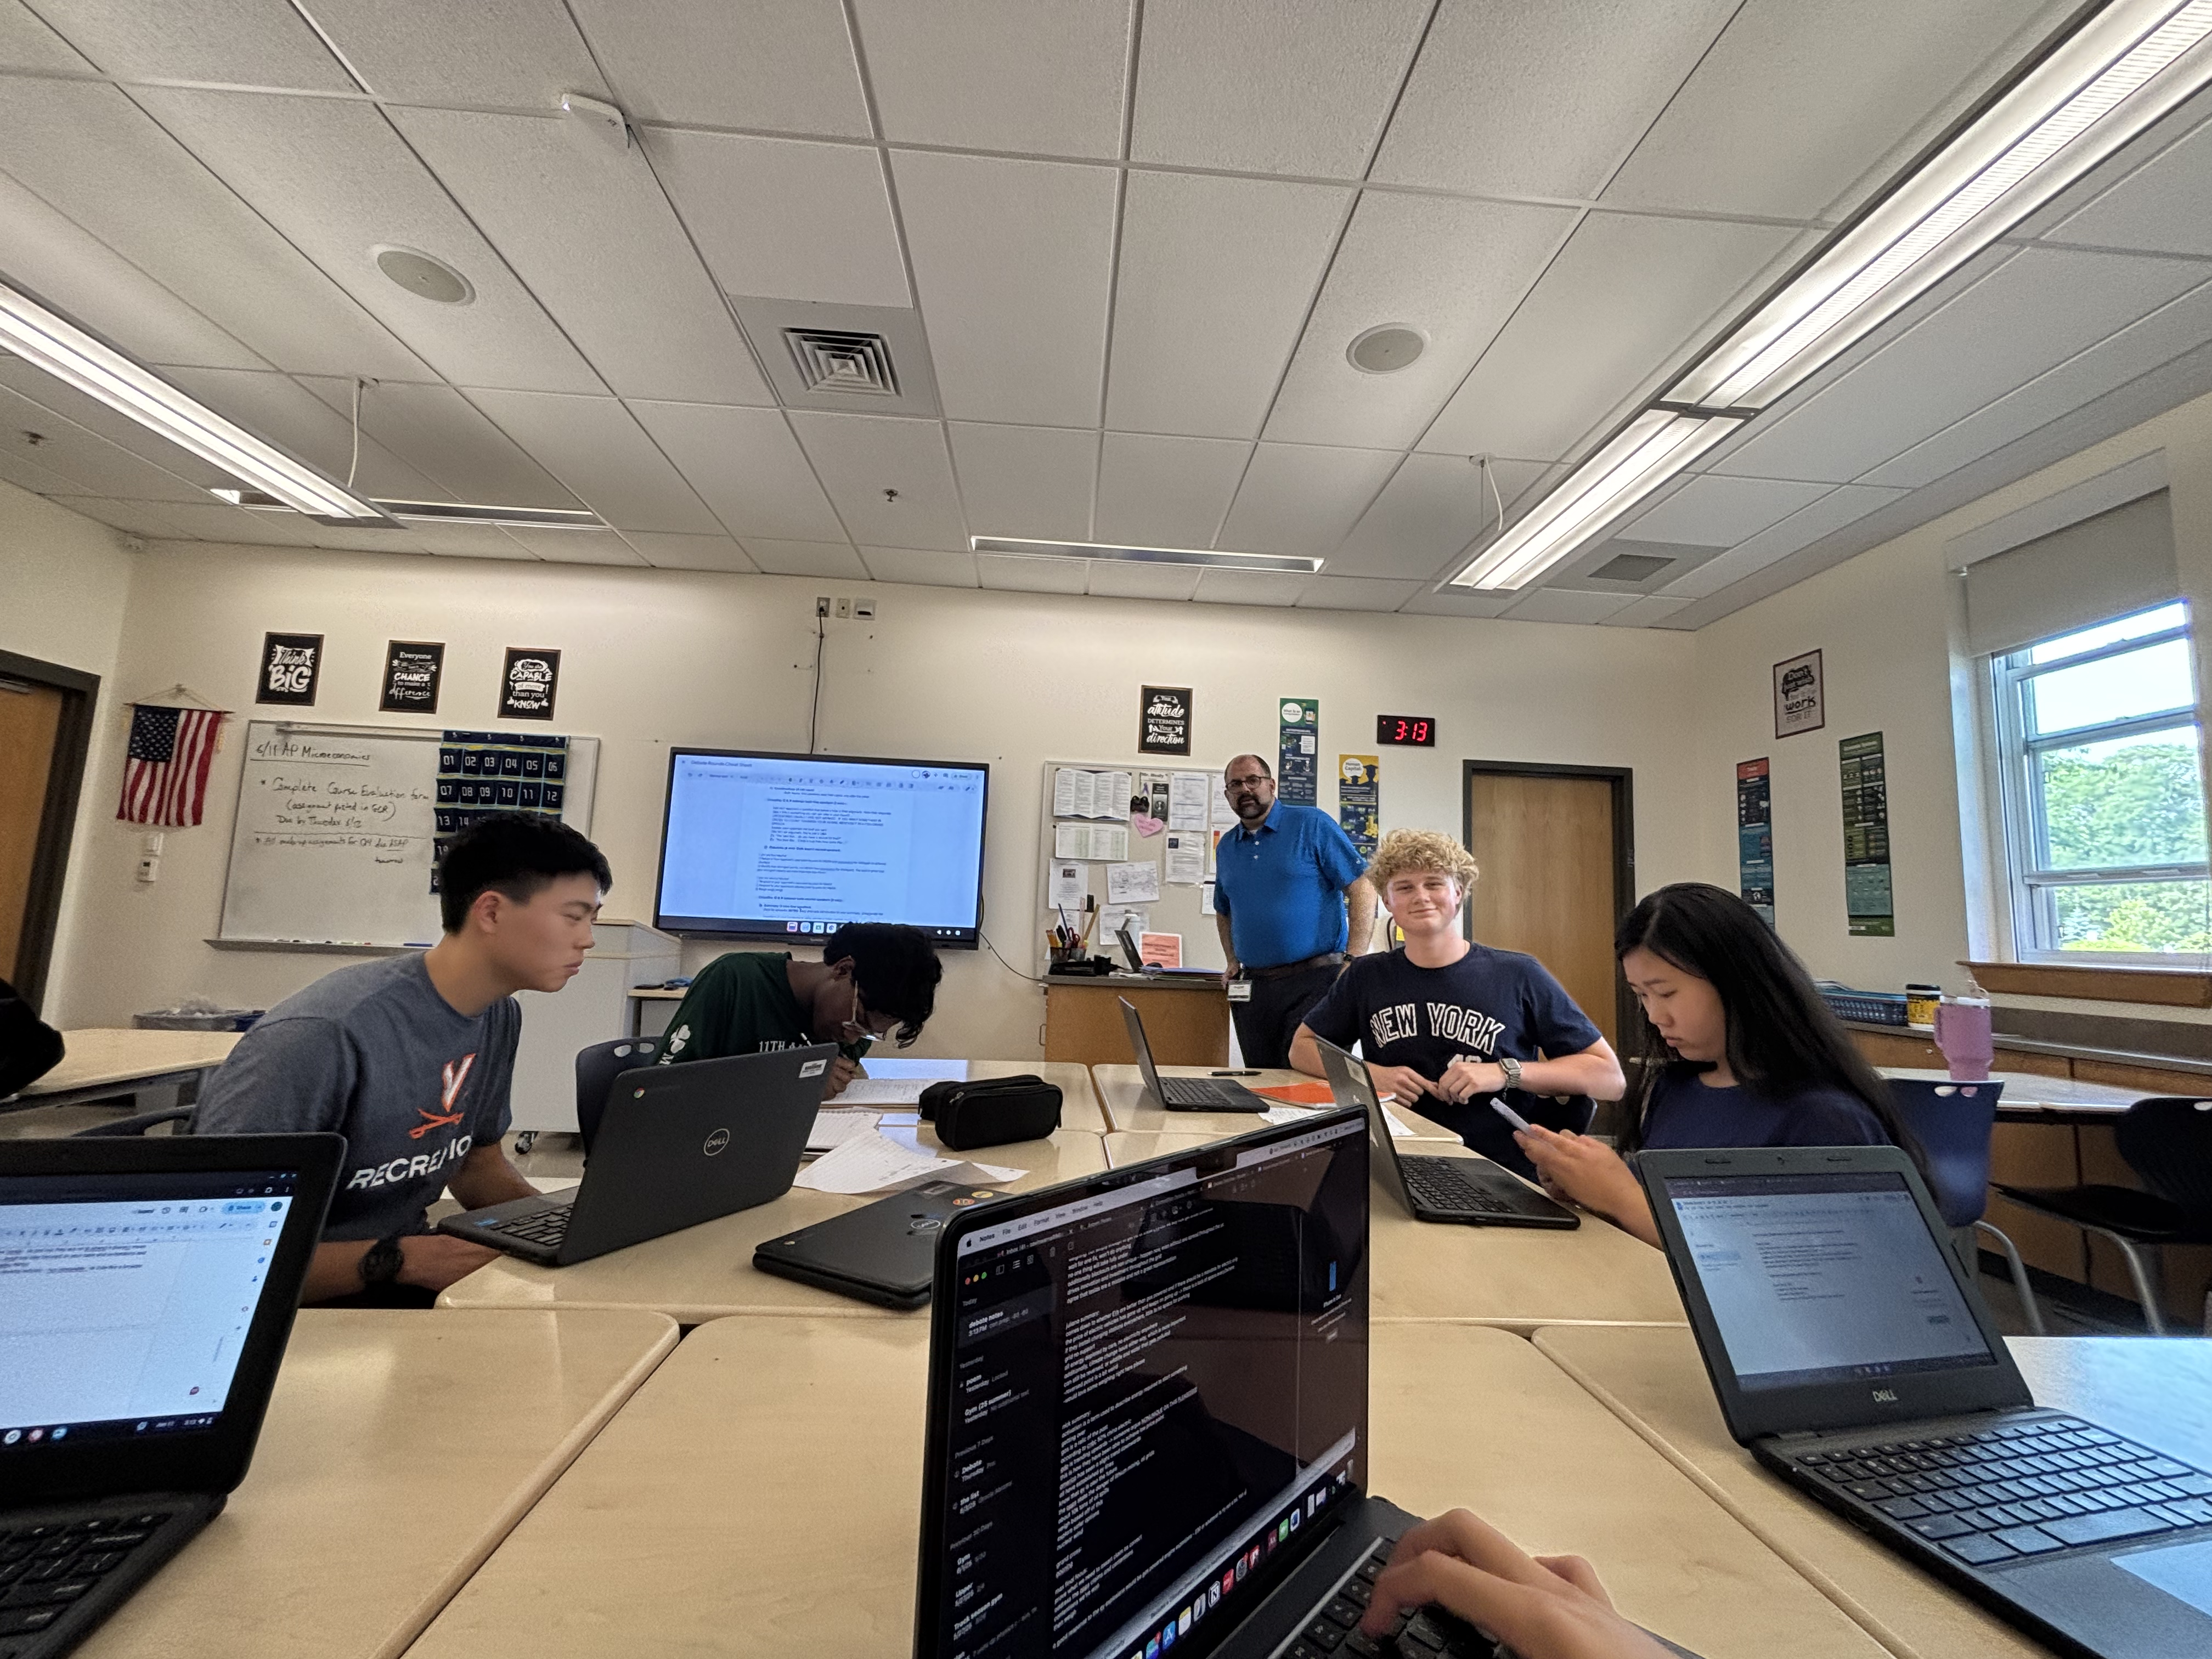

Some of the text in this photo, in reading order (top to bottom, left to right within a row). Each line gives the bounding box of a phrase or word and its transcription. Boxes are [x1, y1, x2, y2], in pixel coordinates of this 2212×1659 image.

[278, 648, 307, 664] Think
[399, 652, 432, 660] Everyone
[394, 672, 430, 681] CHANCE
[510, 670, 552, 682] CAPABLE
[389, 686, 430, 699] difference
[513, 699, 541, 709] KNOW
[1147, 703, 1184, 716] attitude
[1785, 695, 1816, 711] work
[1395, 720, 1427, 741] 3:13
[1146, 732, 1184, 744] direction
[283, 743, 298, 755] AP
[302, 747, 369, 761] Microeconomics
[443, 755, 557, 772] 01 02 03 04 05 06
[273, 777, 317, 793] Complete
[328, 782, 358, 795] Course
[440, 785, 557, 802] 07 08 09 10 11 12
[438, 815, 450, 826] 13
[459, 816, 469, 826] 14
[1370, 1002, 1506, 1056] NEW YORK
[759, 1041, 784, 1053] 11TH
[707, 1137, 727, 1148] DELL
[980, 1234, 995, 1242] Notes
[1034, 1217, 1049, 1226] Format
[969, 1311, 1003, 1328] debate notes
[967, 1375, 981, 1386] poem
[964, 1407, 977, 1415] Gym
[989, 1390, 1011, 1404] summer)
[1872, 1389, 1898, 1403] DELL
[962, 1460, 982, 1474] Debate
[960, 1491, 979, 1505] the list
[957, 1554, 970, 1565] Gym
[954, 1593, 1002, 1630] Track season gym
